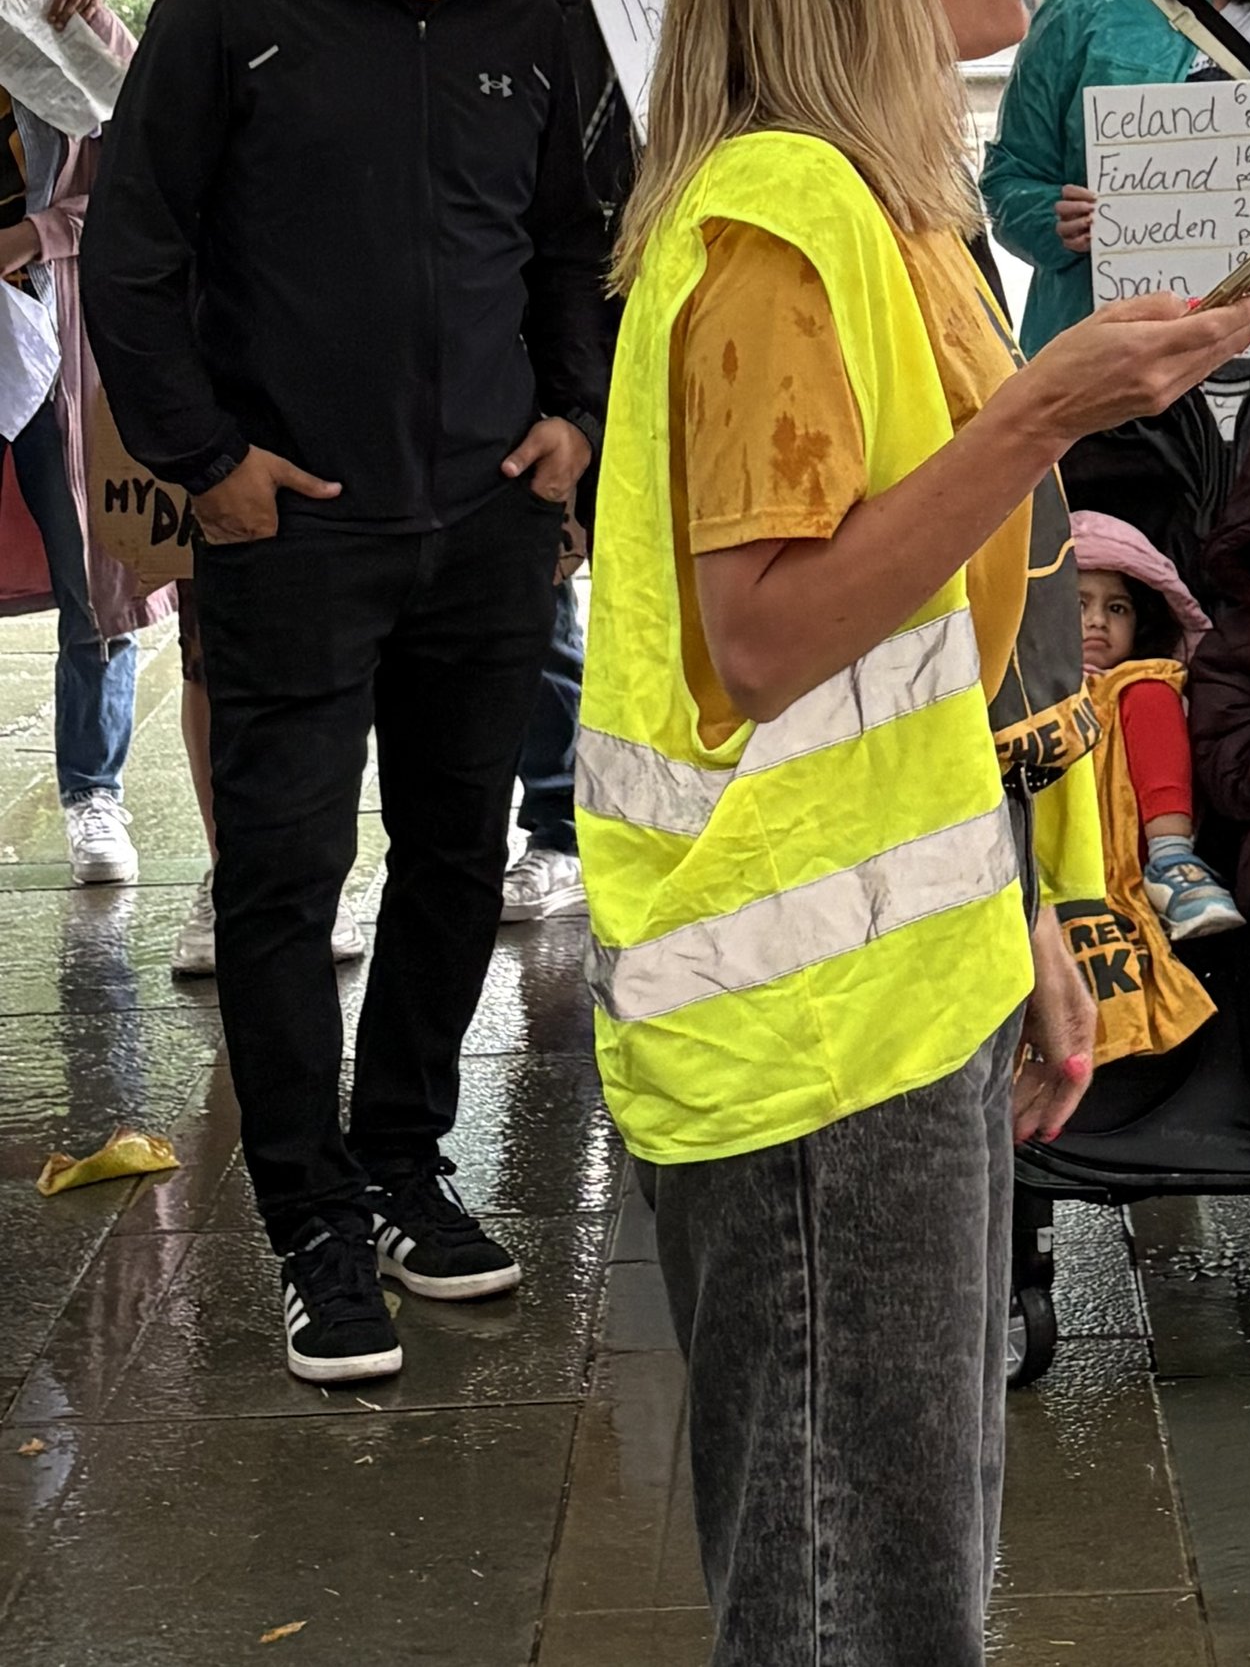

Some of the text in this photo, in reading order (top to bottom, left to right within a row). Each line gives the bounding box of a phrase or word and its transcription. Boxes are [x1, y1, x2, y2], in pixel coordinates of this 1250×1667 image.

[1093, 94, 1221, 142] Iceland
[1233, 82, 1248, 104] 6
[1097, 152, 1219, 193] Finland
[1097, 203, 1217, 248] Sweden
[1096, 260, 1191, 301] Spain
[104, 477, 155, 515] MY
